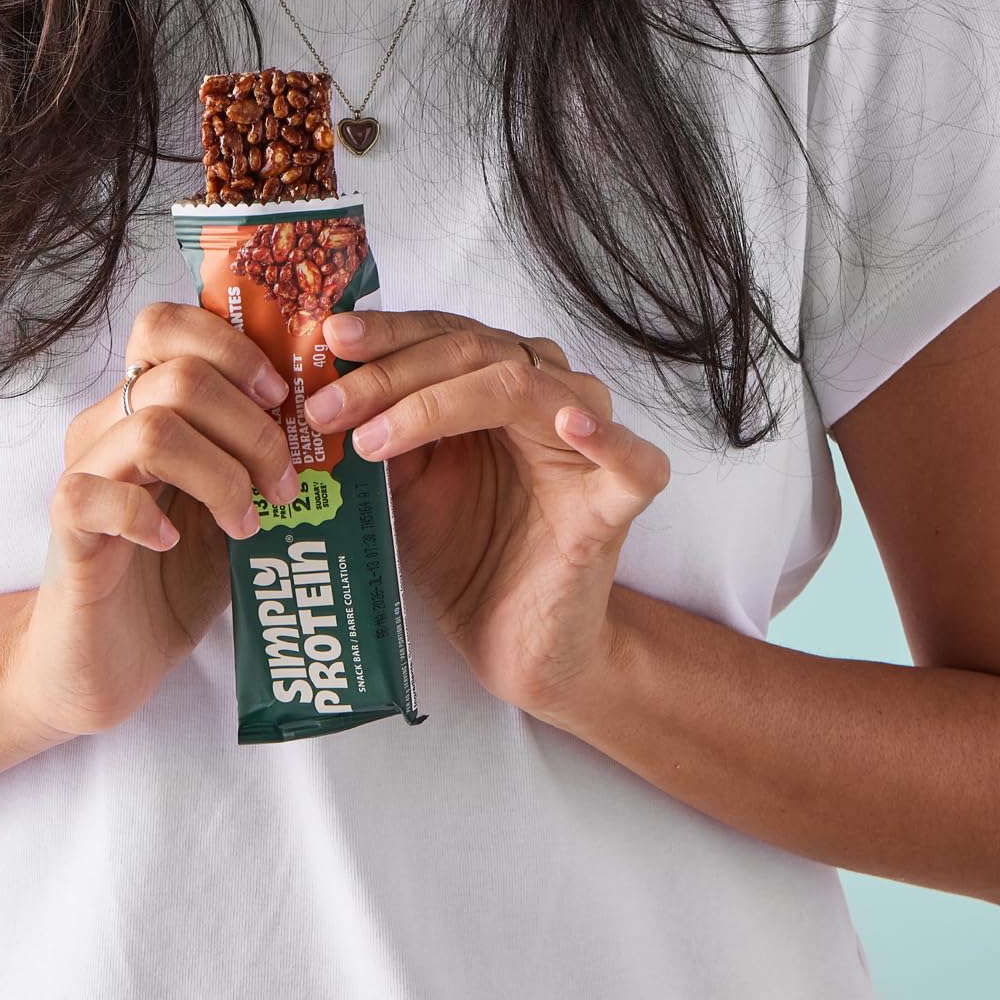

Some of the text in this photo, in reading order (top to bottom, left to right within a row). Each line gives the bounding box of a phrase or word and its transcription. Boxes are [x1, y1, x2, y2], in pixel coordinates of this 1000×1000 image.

[293, 353, 303, 372] ET
[312, 344, 329, 368] 40 g
[285, 417, 302, 465] BEURRE
[292, 497, 311, 512] 2
[338, 555, 353, 605] COLLATION
[249, 557, 314, 703] SIMPLY
[287, 541, 353, 714] PROTEIN
[345, 607, 357, 637] BARRE
[351, 644, 362, 663] BAR
[353, 664, 367, 693] SNACK
